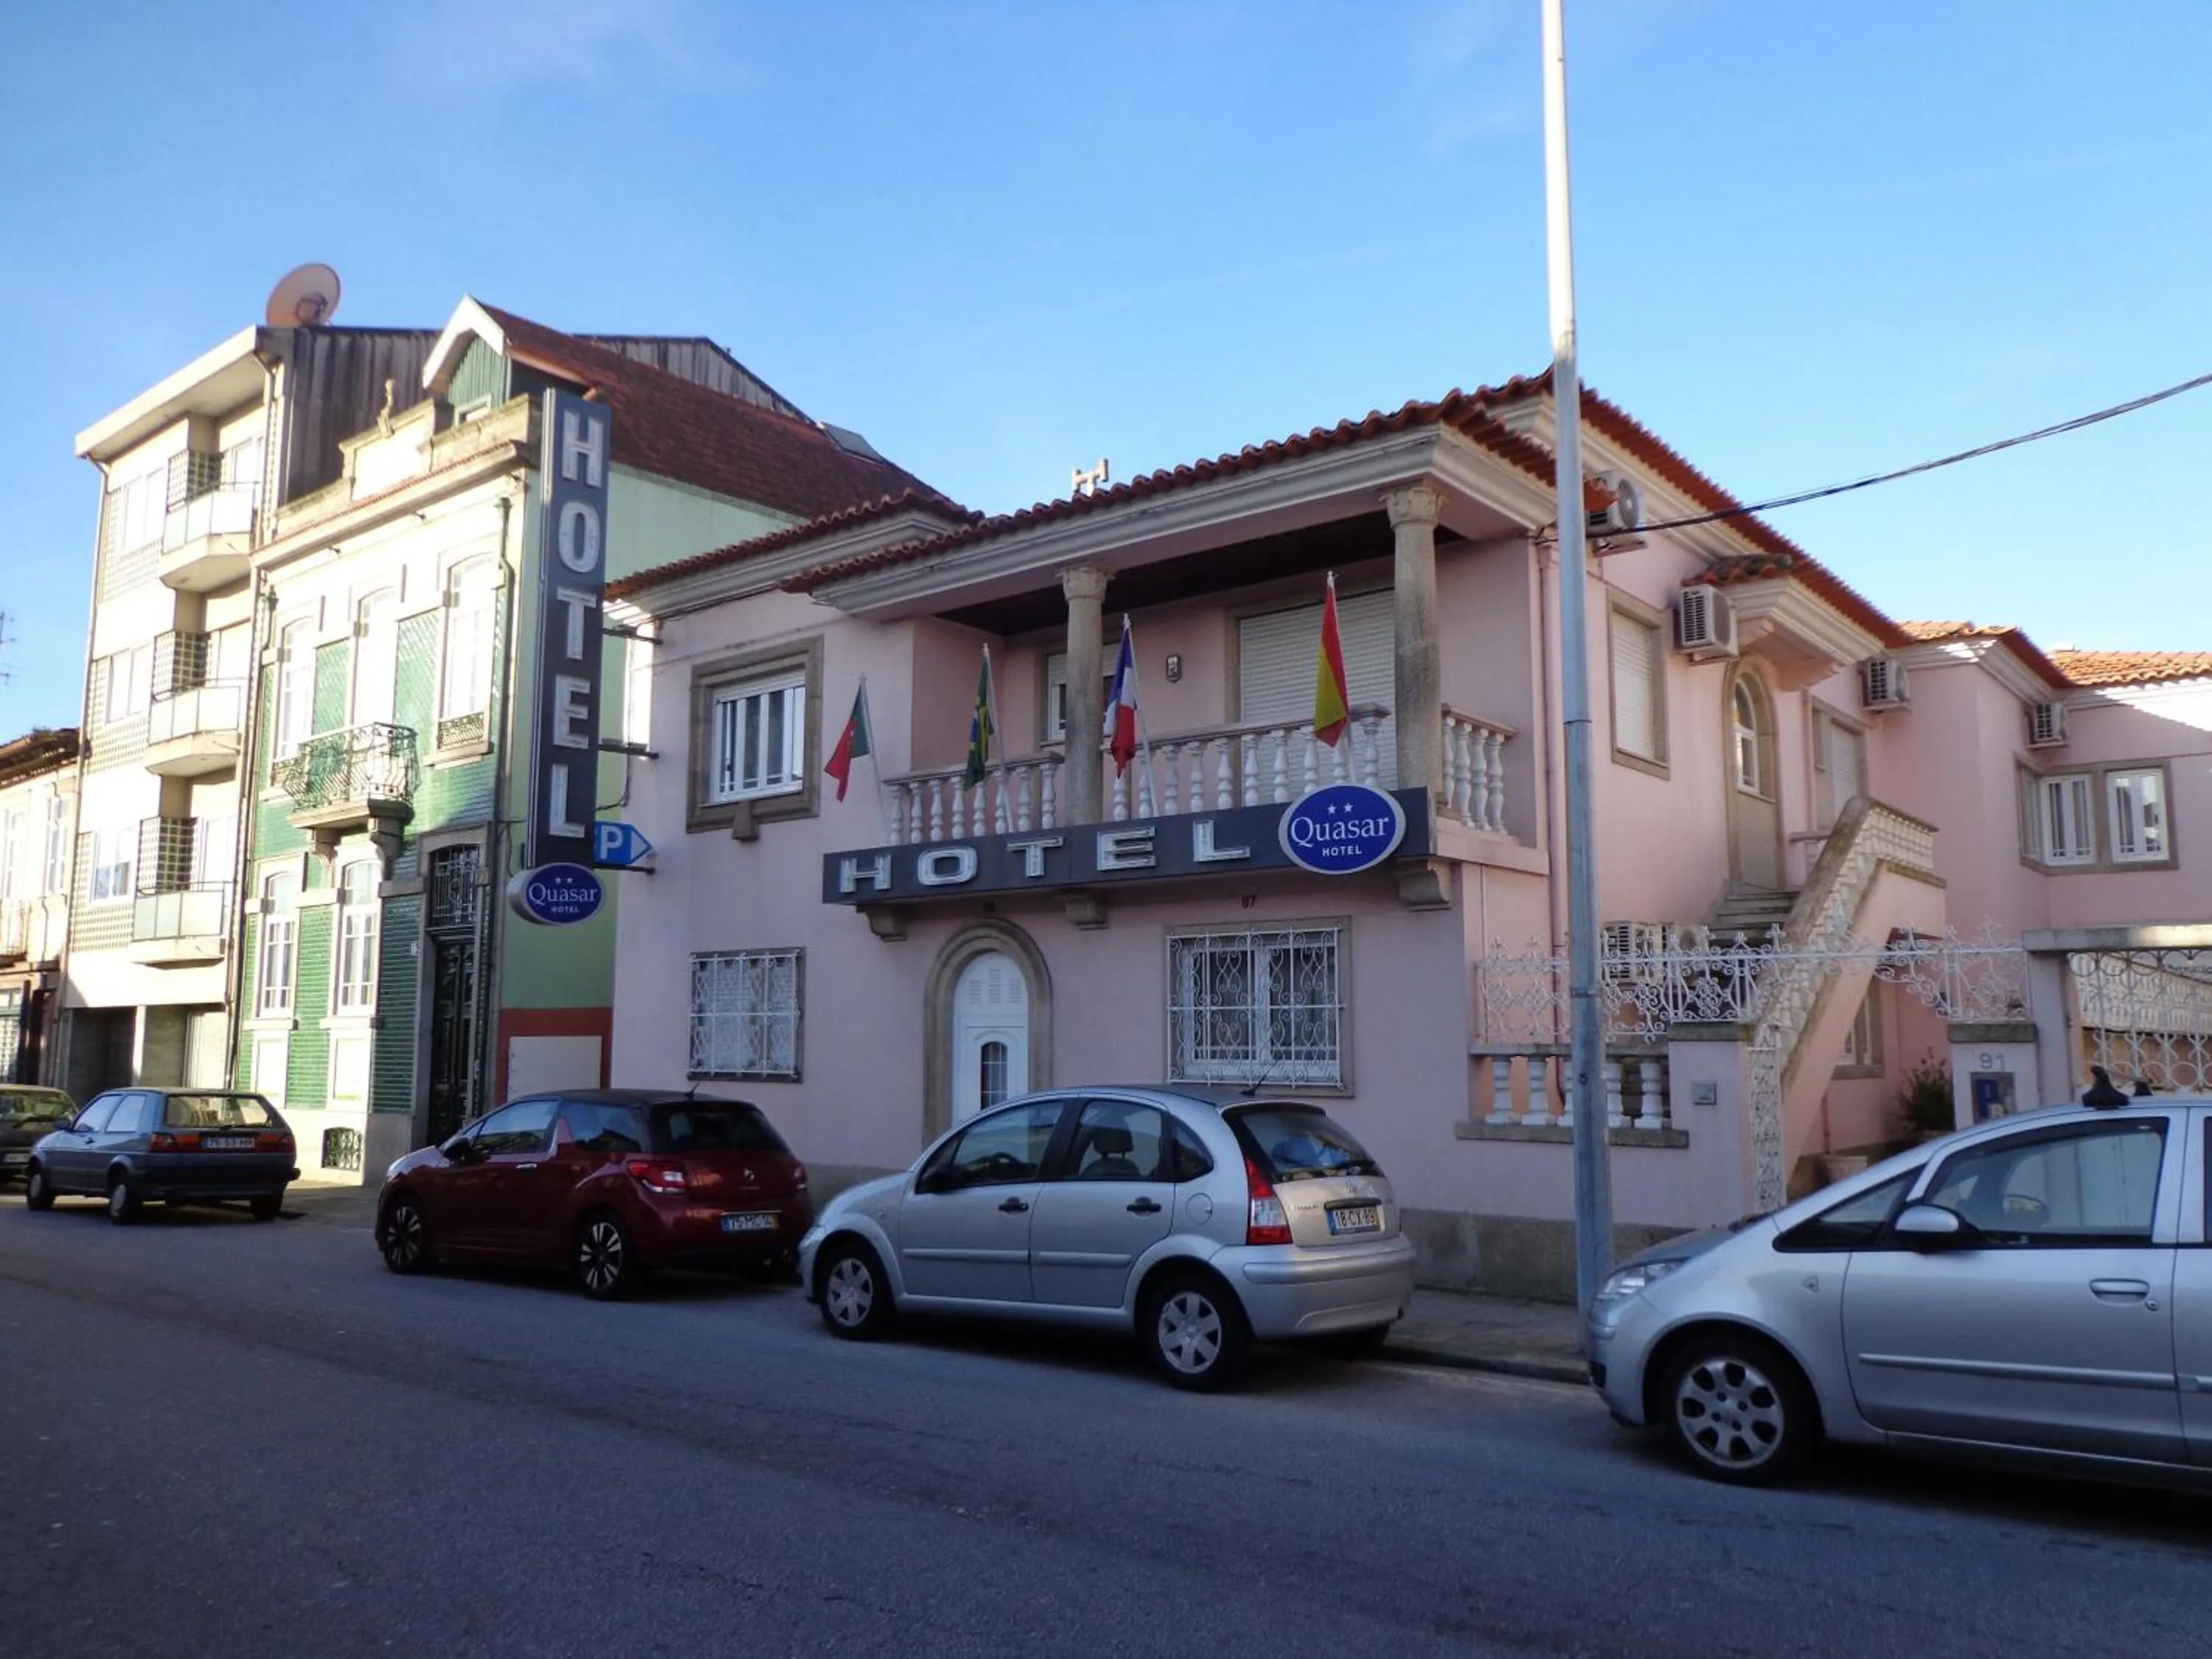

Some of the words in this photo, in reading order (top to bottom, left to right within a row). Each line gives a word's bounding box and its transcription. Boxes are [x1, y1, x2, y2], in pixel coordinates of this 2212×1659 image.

[548, 408, 604, 838] HOTEL
[600, 824, 623, 860] P
[1291, 816, 1389, 847] Quasar
[839, 818, 1251, 893] HOTEL
[1322, 846, 1362, 857] HOTEL
[529, 883, 599, 906] Quasar
[551, 905, 580, 914] HOTEL
[1980, 1053, 2005, 1071] 91
